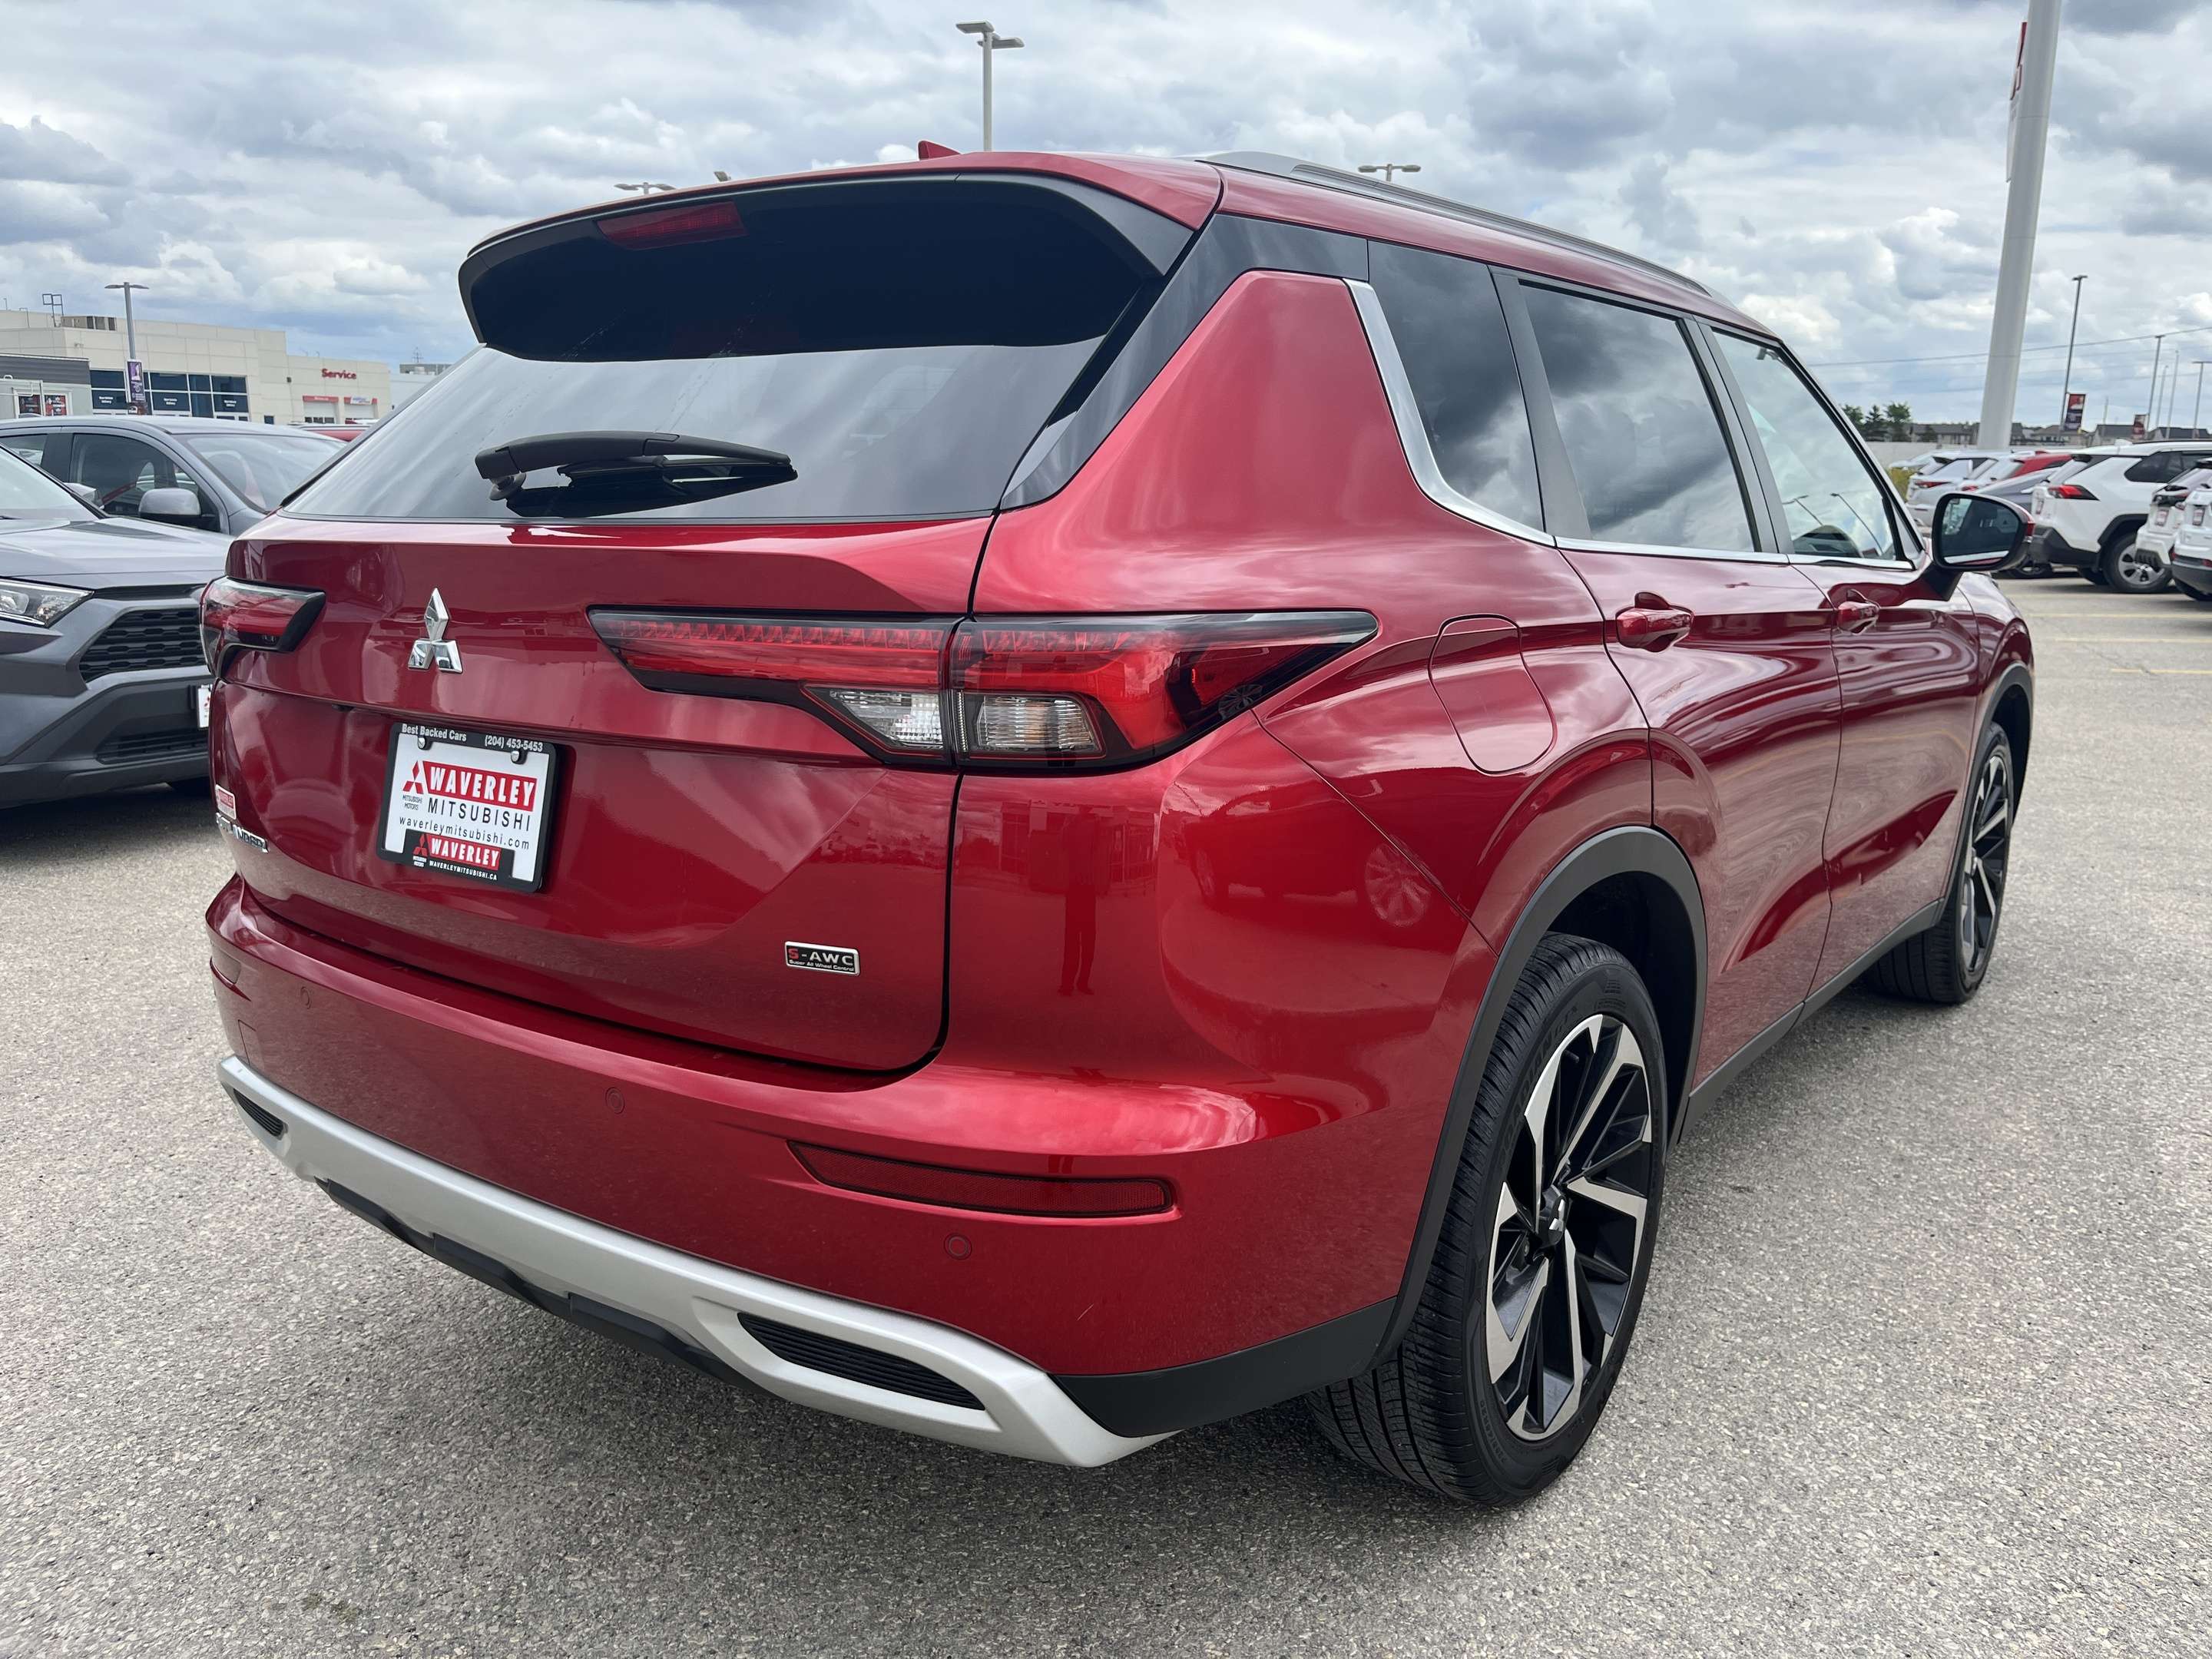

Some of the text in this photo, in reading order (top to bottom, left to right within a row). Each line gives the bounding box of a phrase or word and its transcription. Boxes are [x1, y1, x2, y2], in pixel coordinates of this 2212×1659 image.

[322, 368, 357, 379] Service
[402, 724, 543, 752] Best Backed Cars (204) 453-5453
[430, 766, 535, 806] WAVERLEY
[428, 797, 531, 832] MITSUBISHI
[399, 816, 529, 850] waverleymitsubishi.com
[431, 837, 500, 867] WAVERLEY
[429, 860, 498, 880] WAVERLEYMITSUBISHI.CA
[788, 948, 853, 966] S-AWC
